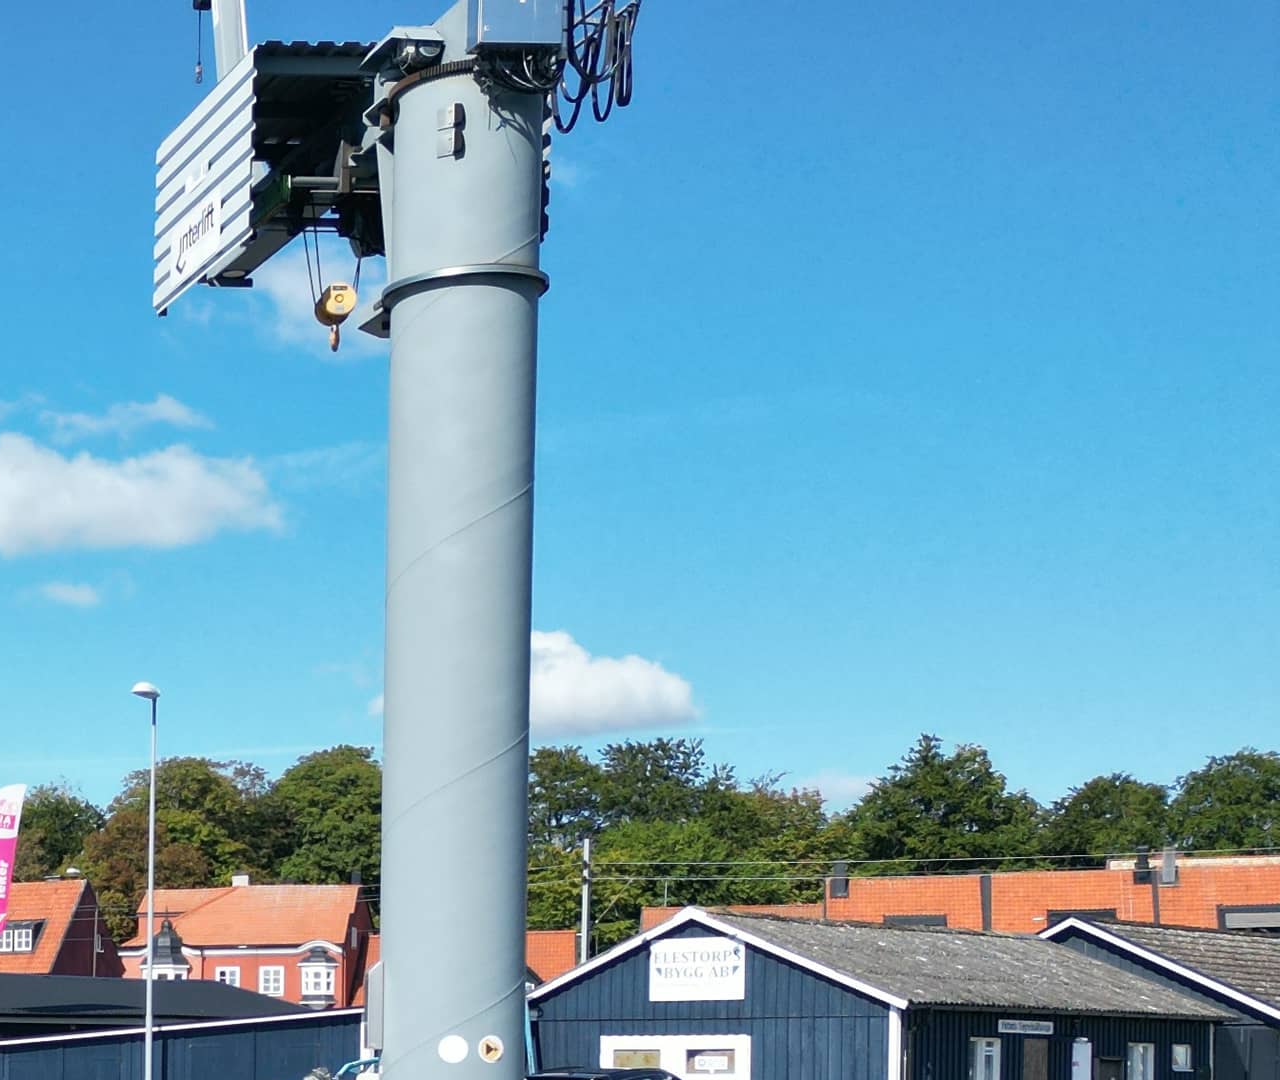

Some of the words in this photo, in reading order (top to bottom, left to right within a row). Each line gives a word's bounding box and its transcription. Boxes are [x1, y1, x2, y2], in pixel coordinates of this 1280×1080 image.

[176, 201, 214, 274] Interlift
[664, 967, 703, 979] BYGG
[709, 966, 729, 978] AB
